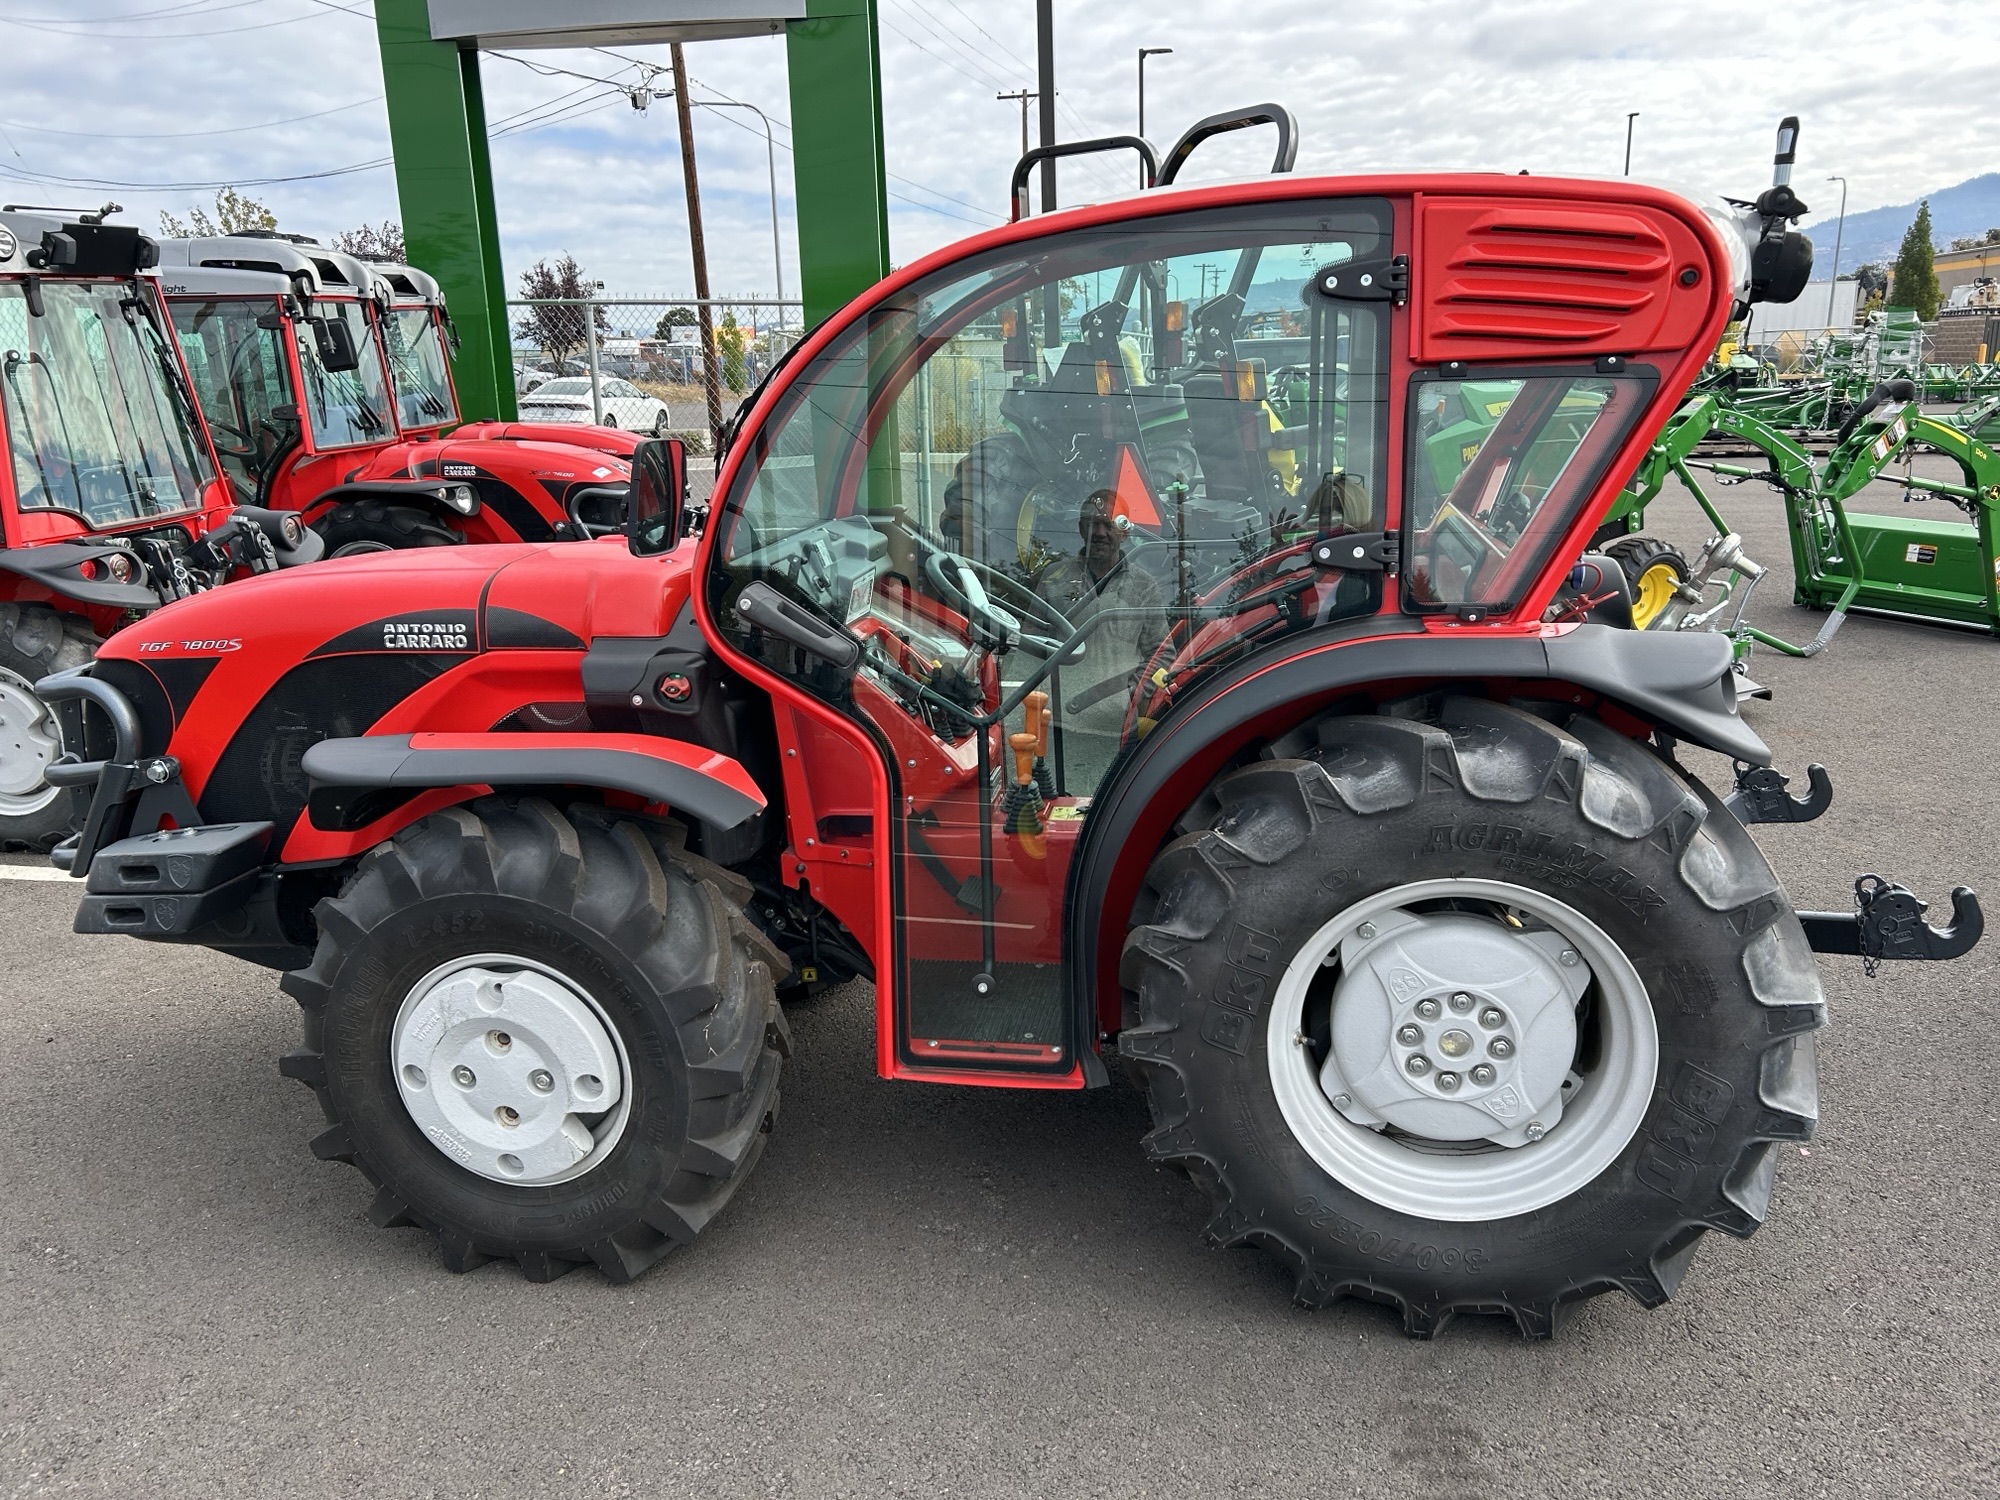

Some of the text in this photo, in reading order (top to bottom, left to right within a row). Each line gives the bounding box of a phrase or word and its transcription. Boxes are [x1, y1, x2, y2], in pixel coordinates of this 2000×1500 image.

[161, 285, 187, 294] light
[444, 469, 477, 477] CARRARO
[383, 623, 467, 633] ANTONIO
[139, 638, 243, 653] TGF 7800S
[383, 633, 467, 649] CARRARO
[1534, 865, 1580, 889] 765
[1205, 927, 1276, 1052] BKT
[337, 955, 389, 1089] TRELLEBORG
[1644, 1066, 1728, 1197] BKT
[577, 1180, 631, 1221] TUBELESS
